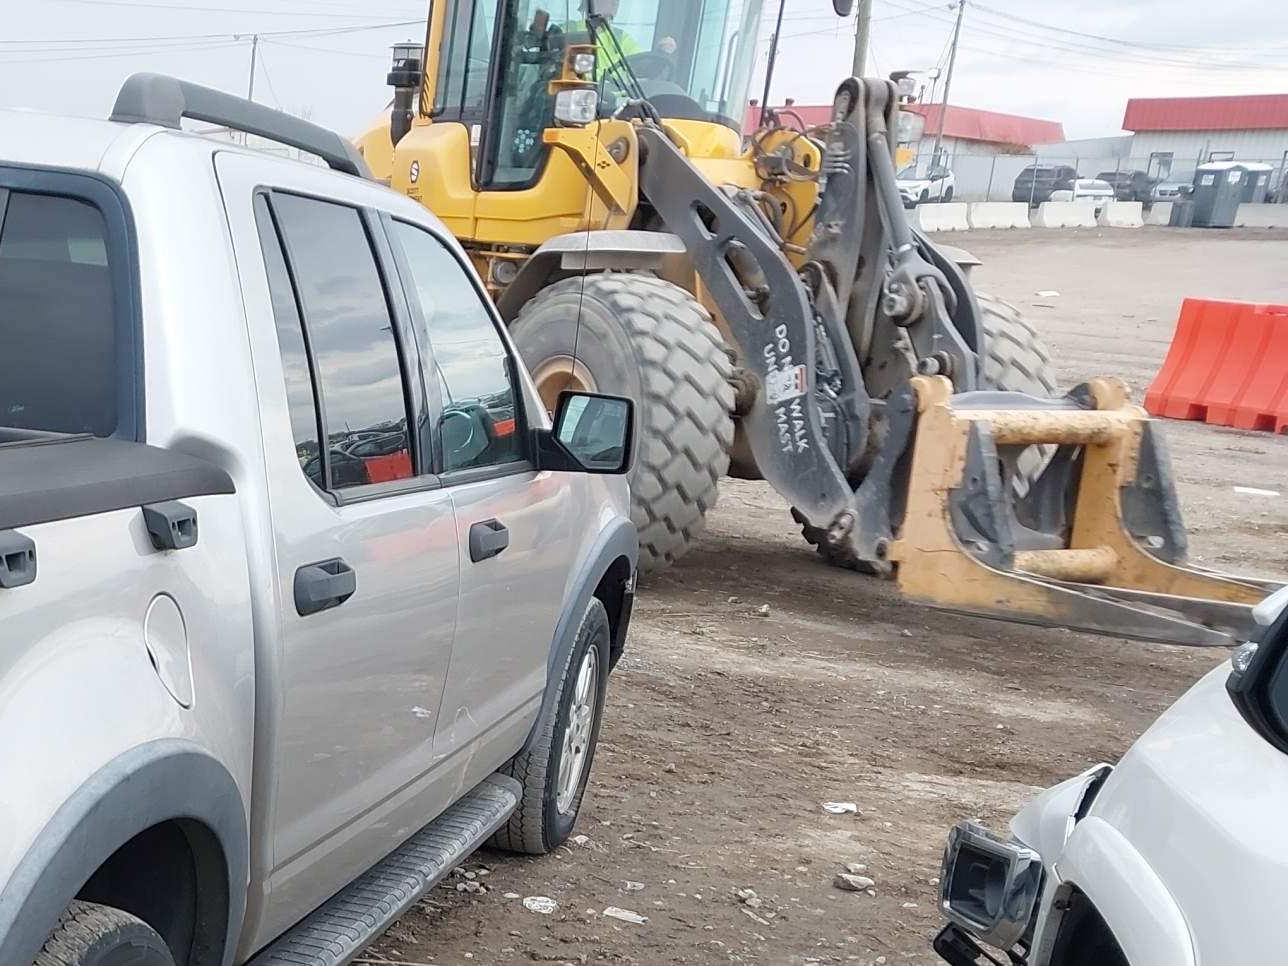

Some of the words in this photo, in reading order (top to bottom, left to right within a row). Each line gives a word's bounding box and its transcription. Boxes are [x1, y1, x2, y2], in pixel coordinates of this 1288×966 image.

[775, 323, 791, 353] DO
[790, 398, 809, 454] WALK
[775, 406, 793, 452] MAST
